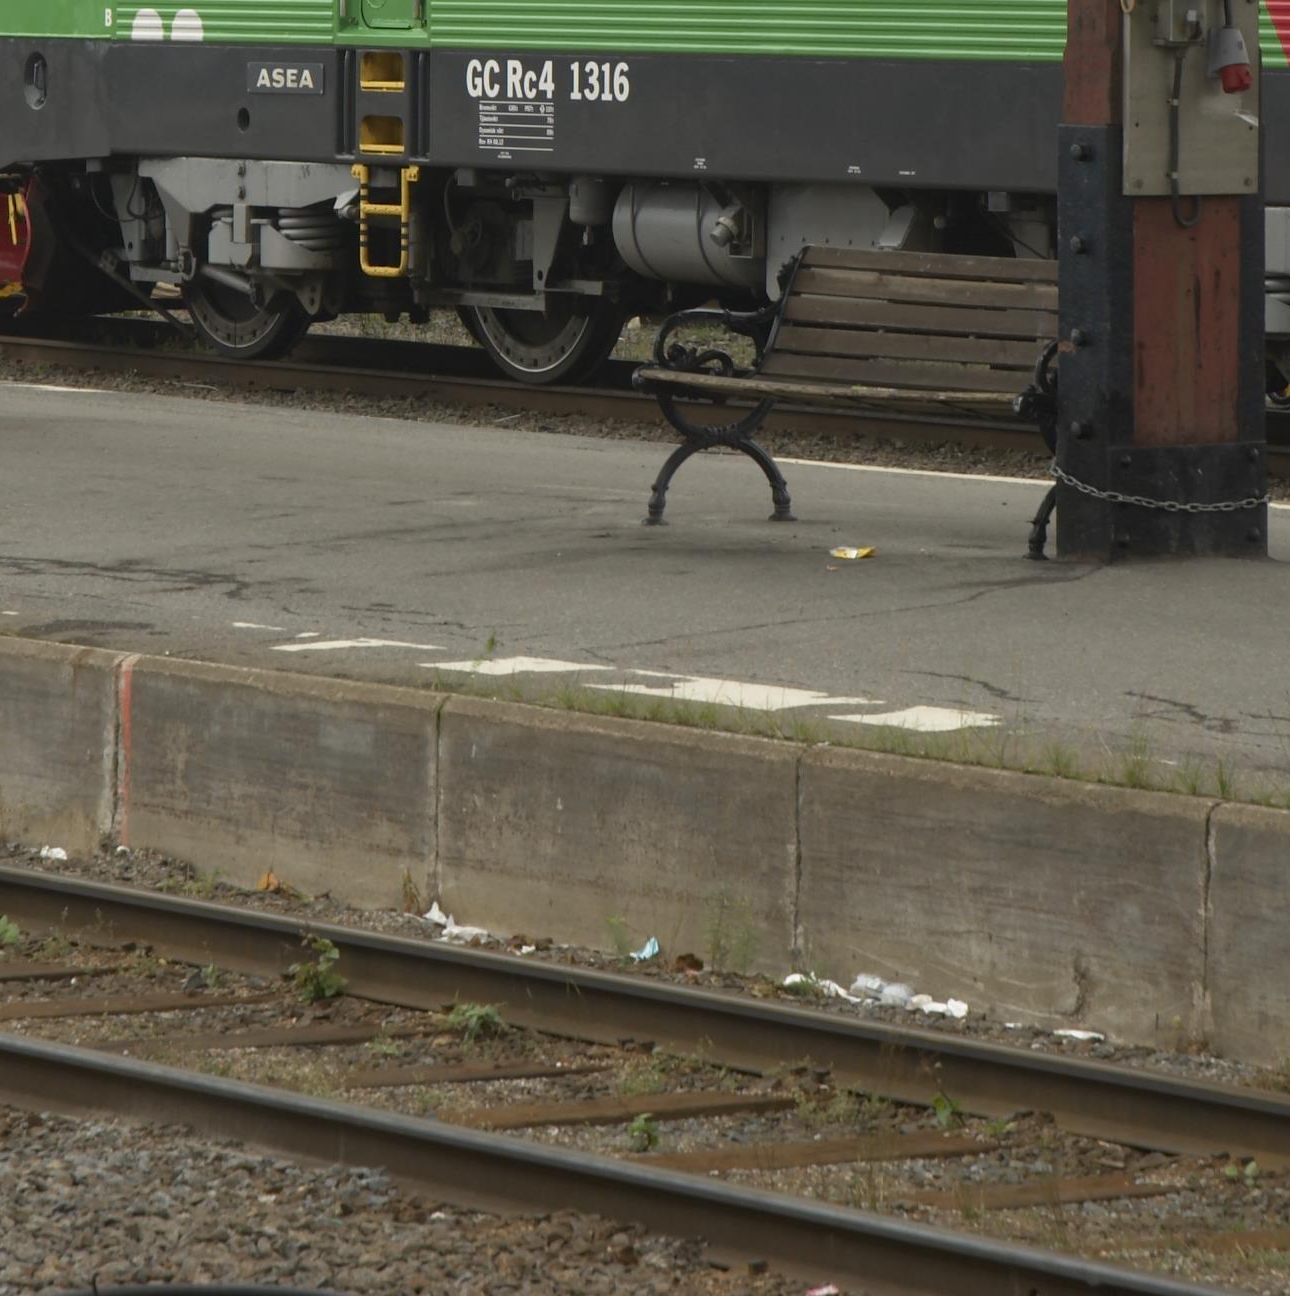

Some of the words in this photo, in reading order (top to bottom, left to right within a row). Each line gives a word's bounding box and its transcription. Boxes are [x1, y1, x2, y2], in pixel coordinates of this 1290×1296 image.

[105, 8, 113, 27] B
[256, 68, 314, 89] ASEA
[466, 59, 500, 98] GC
[506, 59, 555, 99] Rc4
[570, 61, 630, 102] 1316
